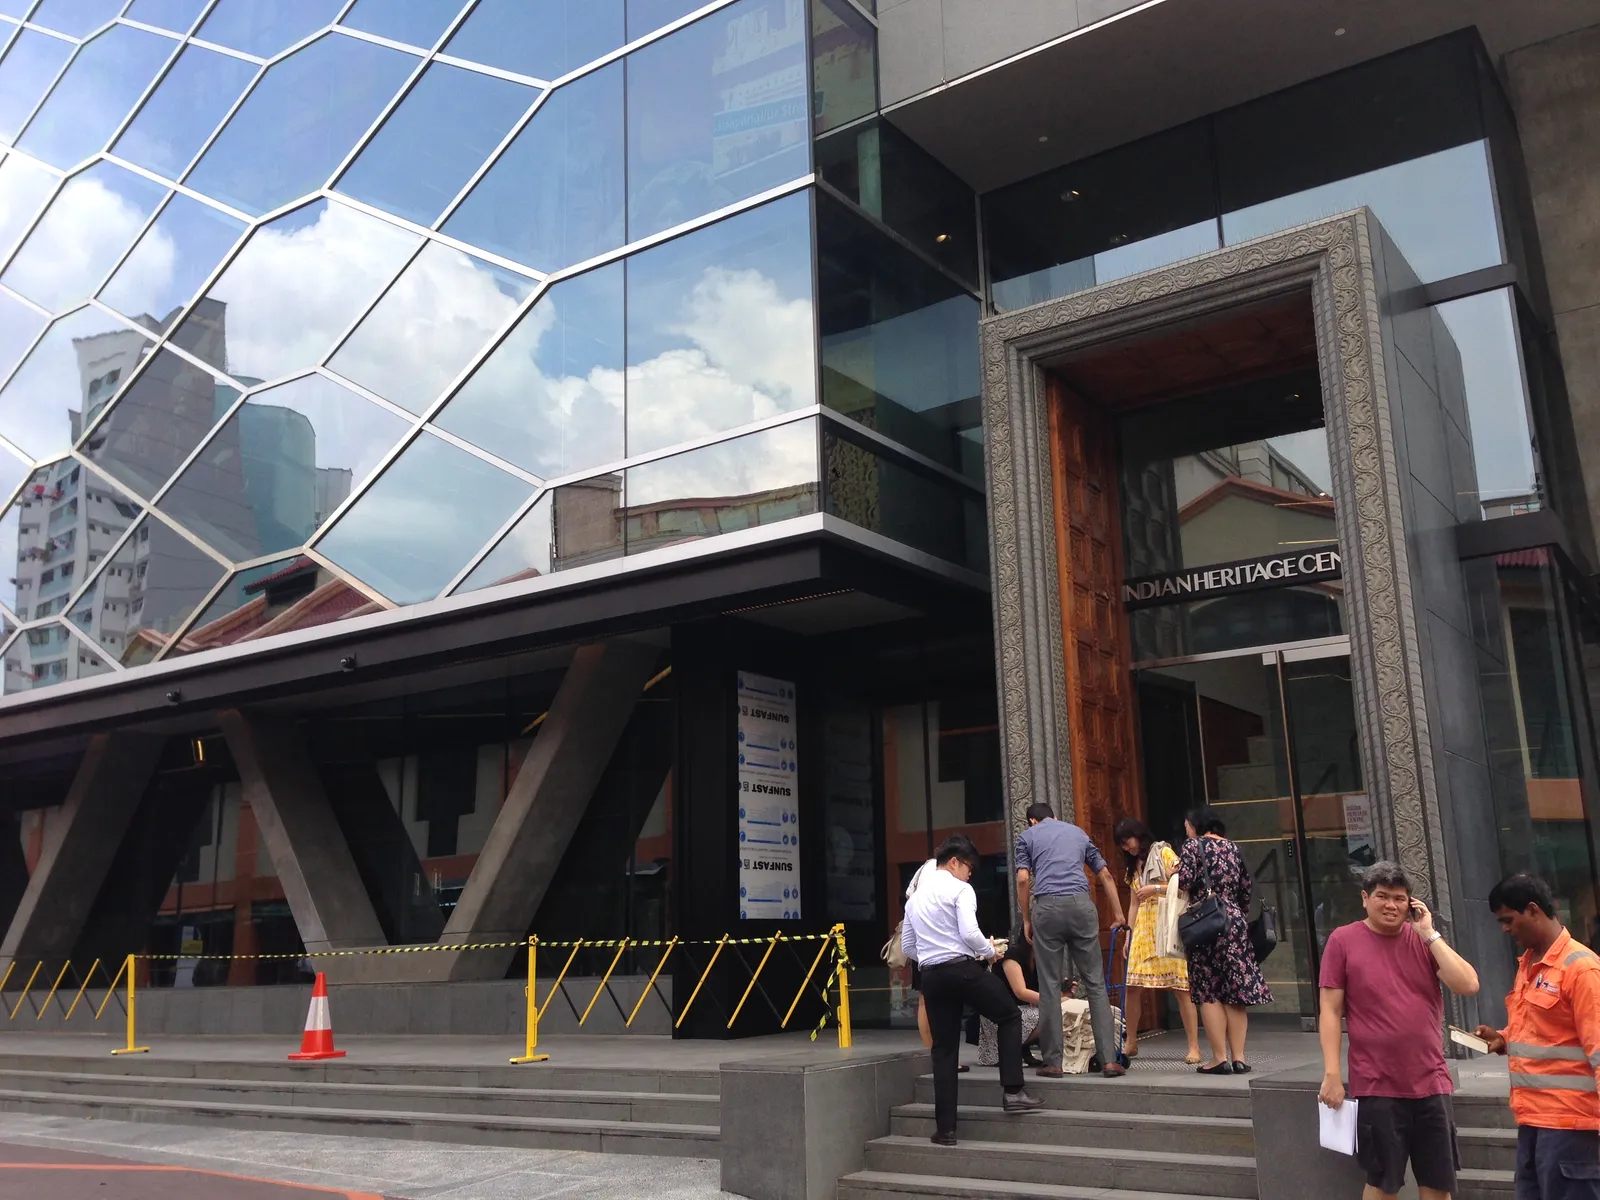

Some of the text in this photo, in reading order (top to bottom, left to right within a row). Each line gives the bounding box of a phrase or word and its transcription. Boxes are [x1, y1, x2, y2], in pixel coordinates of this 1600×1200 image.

[1121, 575, 1192, 602] INDIAN
[1194, 557, 1298, 592] HERITAGE
[751, 708, 790, 723] SUNFAST
[751, 783, 791, 797] SUNFAST
[752, 860, 792, 872] SUNFAST
